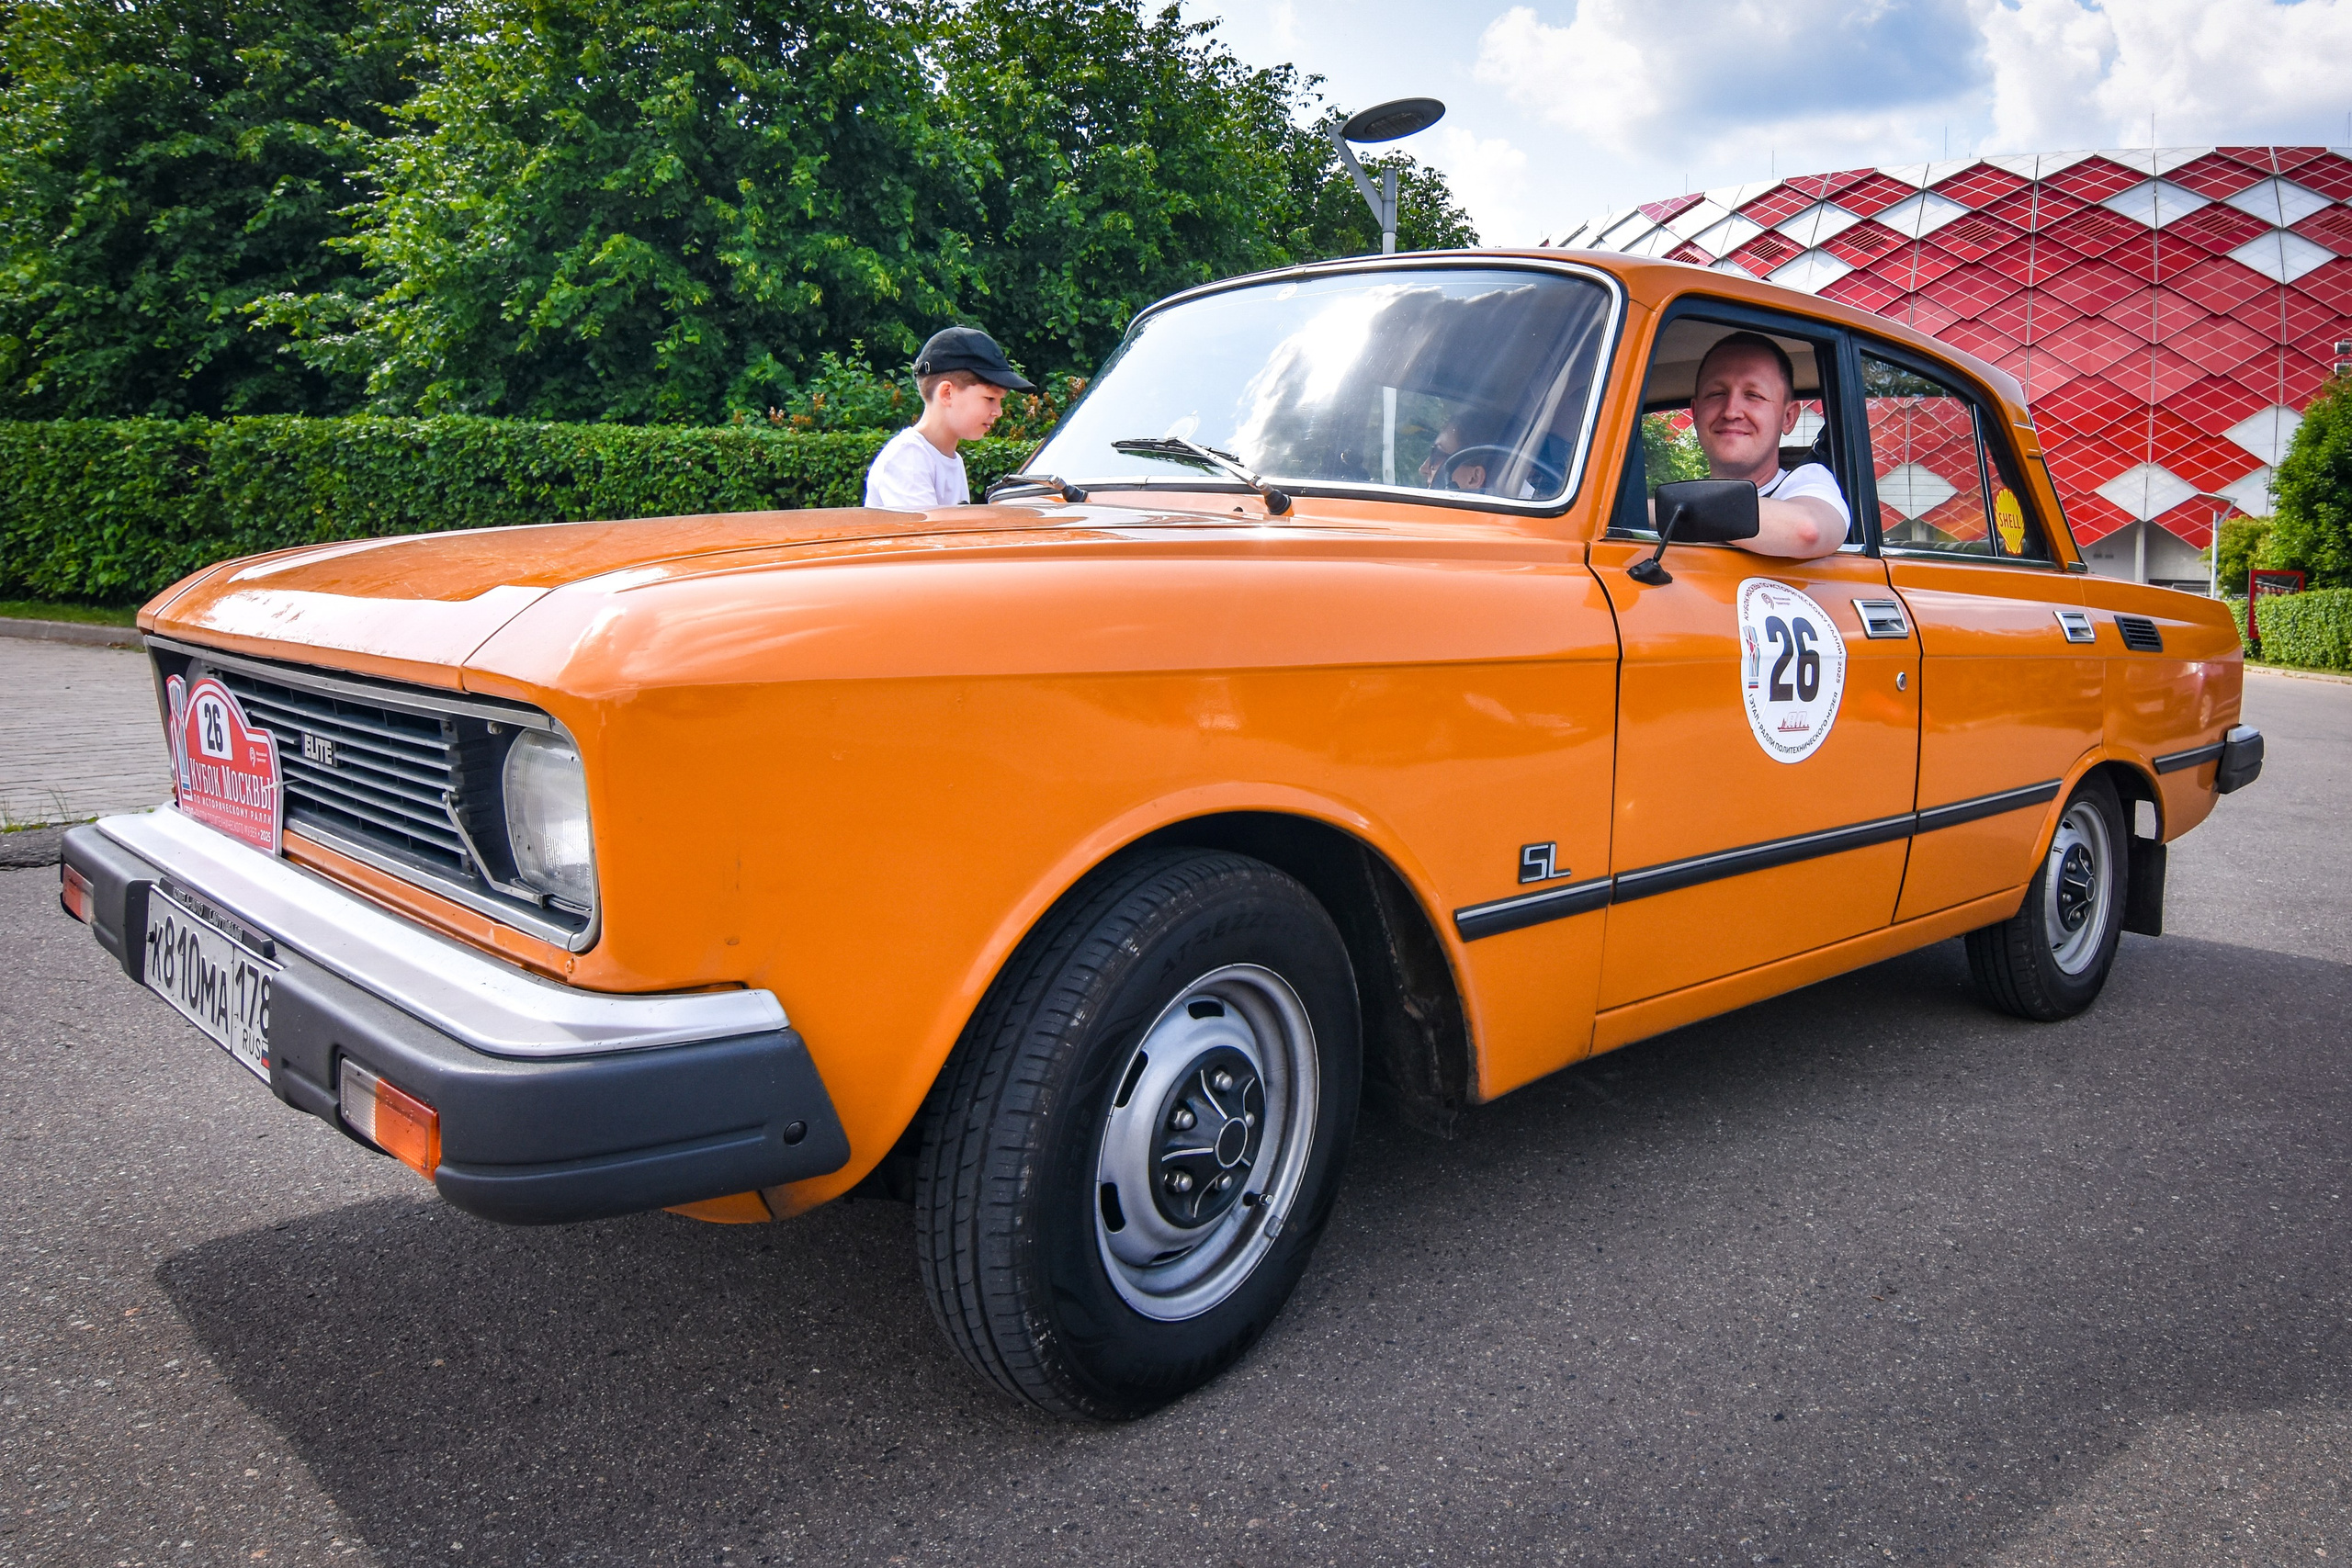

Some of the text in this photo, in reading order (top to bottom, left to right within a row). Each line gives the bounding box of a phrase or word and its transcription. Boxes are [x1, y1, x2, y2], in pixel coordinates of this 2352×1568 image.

[1998, 512, 2021, 529] SHELL
[1827, 624, 1843, 654] РАЛЛИ
[1765, 615, 1819, 703] 26
[204, 703, 223, 752] 26
[1749, 698, 1759, 721] ЭТАП
[1758, 724, 1775, 747] РАЛЛИ
[1774, 719, 1828, 754] ПОЛИТЕХНИЧЕСКОГО
[1826, 692, 1838, 720] МУЗЕЯ
[304, 734, 333, 765] ELITE
[189, 758, 272, 810] КУБОК МОСКВЫ
[203, 796, 248, 818] ИСТОРИЧЕСКОМУ
[250, 810, 272, 825] РАЛЛИ
[260, 829, 271, 842] 2025
[1521, 843, 1571, 883] SL
[235, 960, 272, 1039] 178
[242, 1028, 261, 1060] RUS
